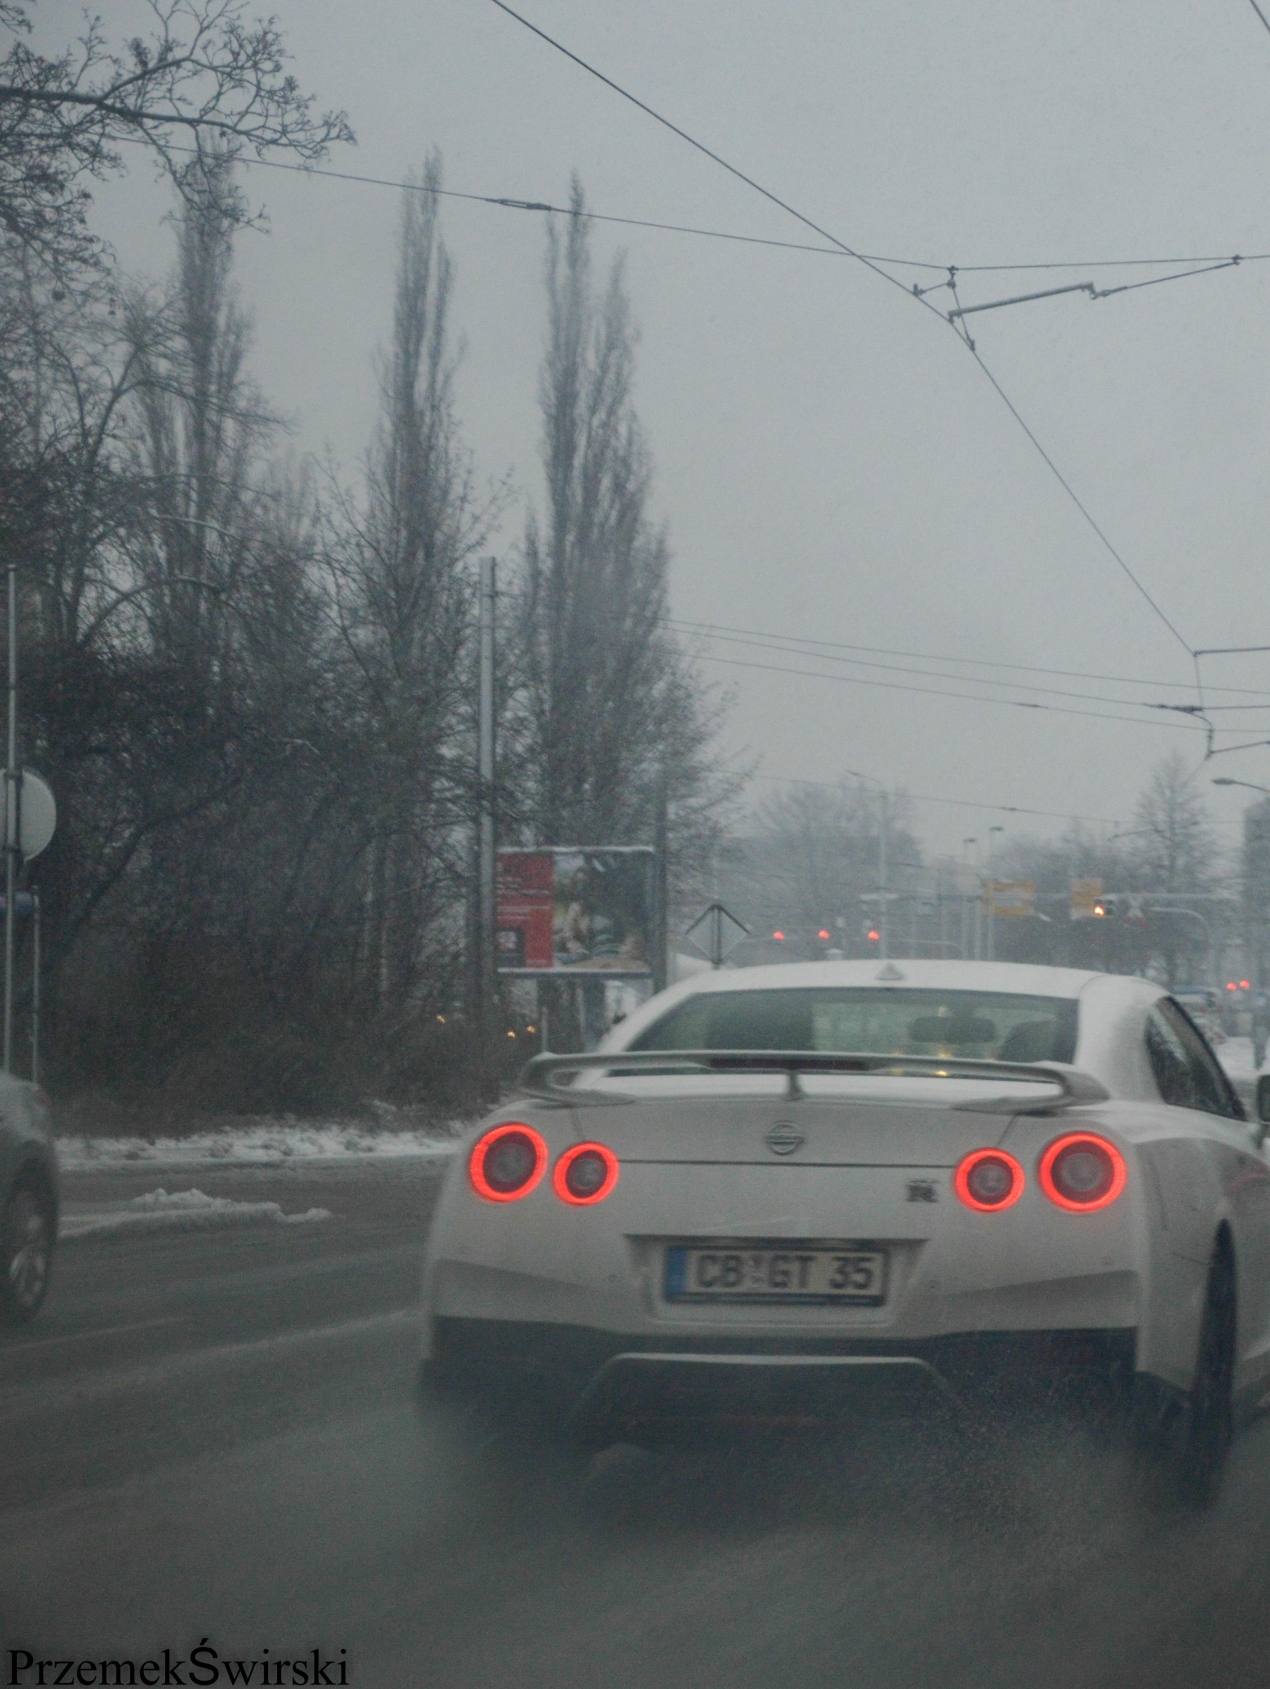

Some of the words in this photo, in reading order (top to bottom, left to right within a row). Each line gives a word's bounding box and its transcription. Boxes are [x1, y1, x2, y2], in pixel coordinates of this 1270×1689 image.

[698, 1253, 743, 1288] CB
[768, 1254, 817, 1289] GT
[829, 1255, 874, 1290] 35
